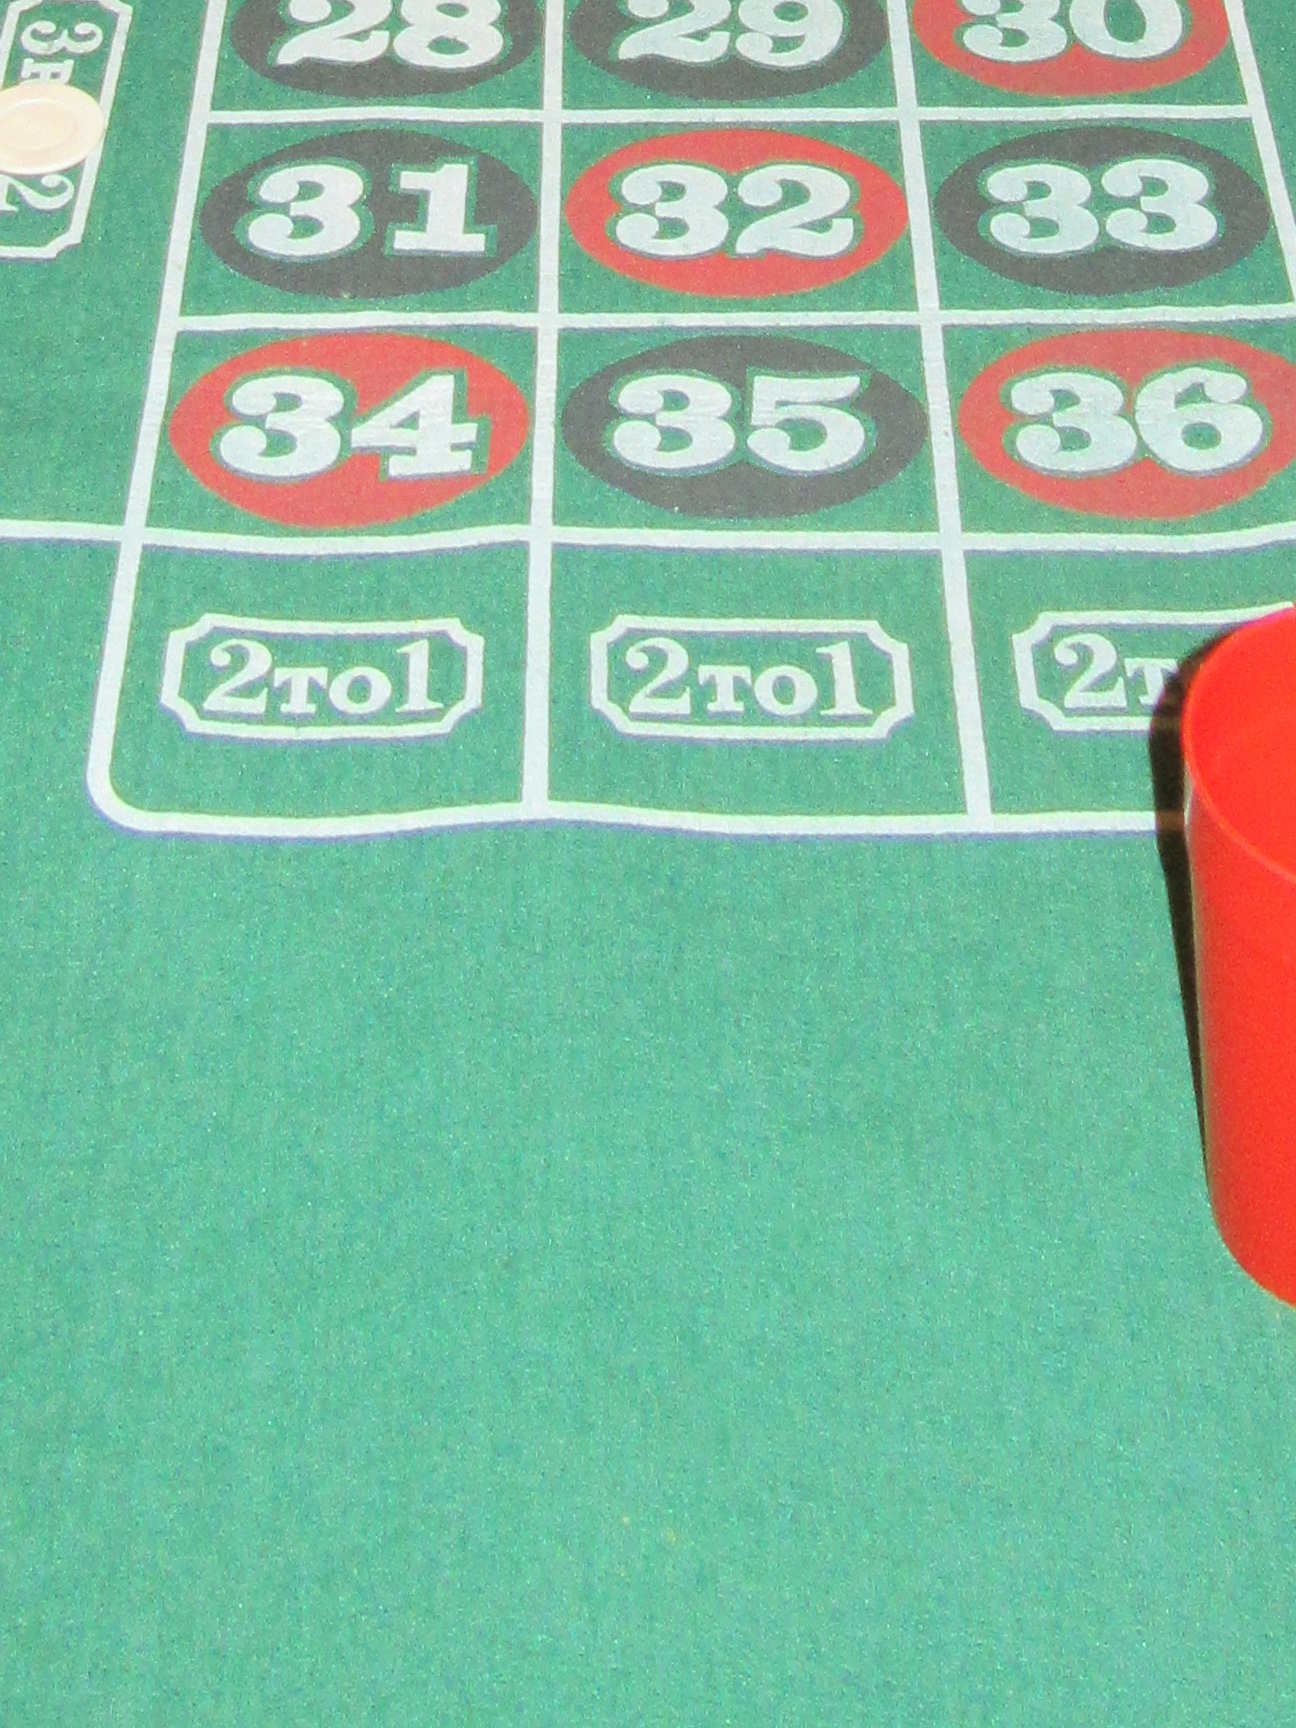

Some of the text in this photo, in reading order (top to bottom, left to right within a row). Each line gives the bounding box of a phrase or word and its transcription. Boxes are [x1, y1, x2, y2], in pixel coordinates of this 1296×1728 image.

[248, 164, 485, 257] 31
[616, 164, 854, 258] 32
[987, 159, 1217, 254] 33
[219, 375, 477, 480] 34
[613, 375, 865, 472] 35
[1011, 368, 1263, 476] 36
[1054, 632, 1179, 709] 2T
